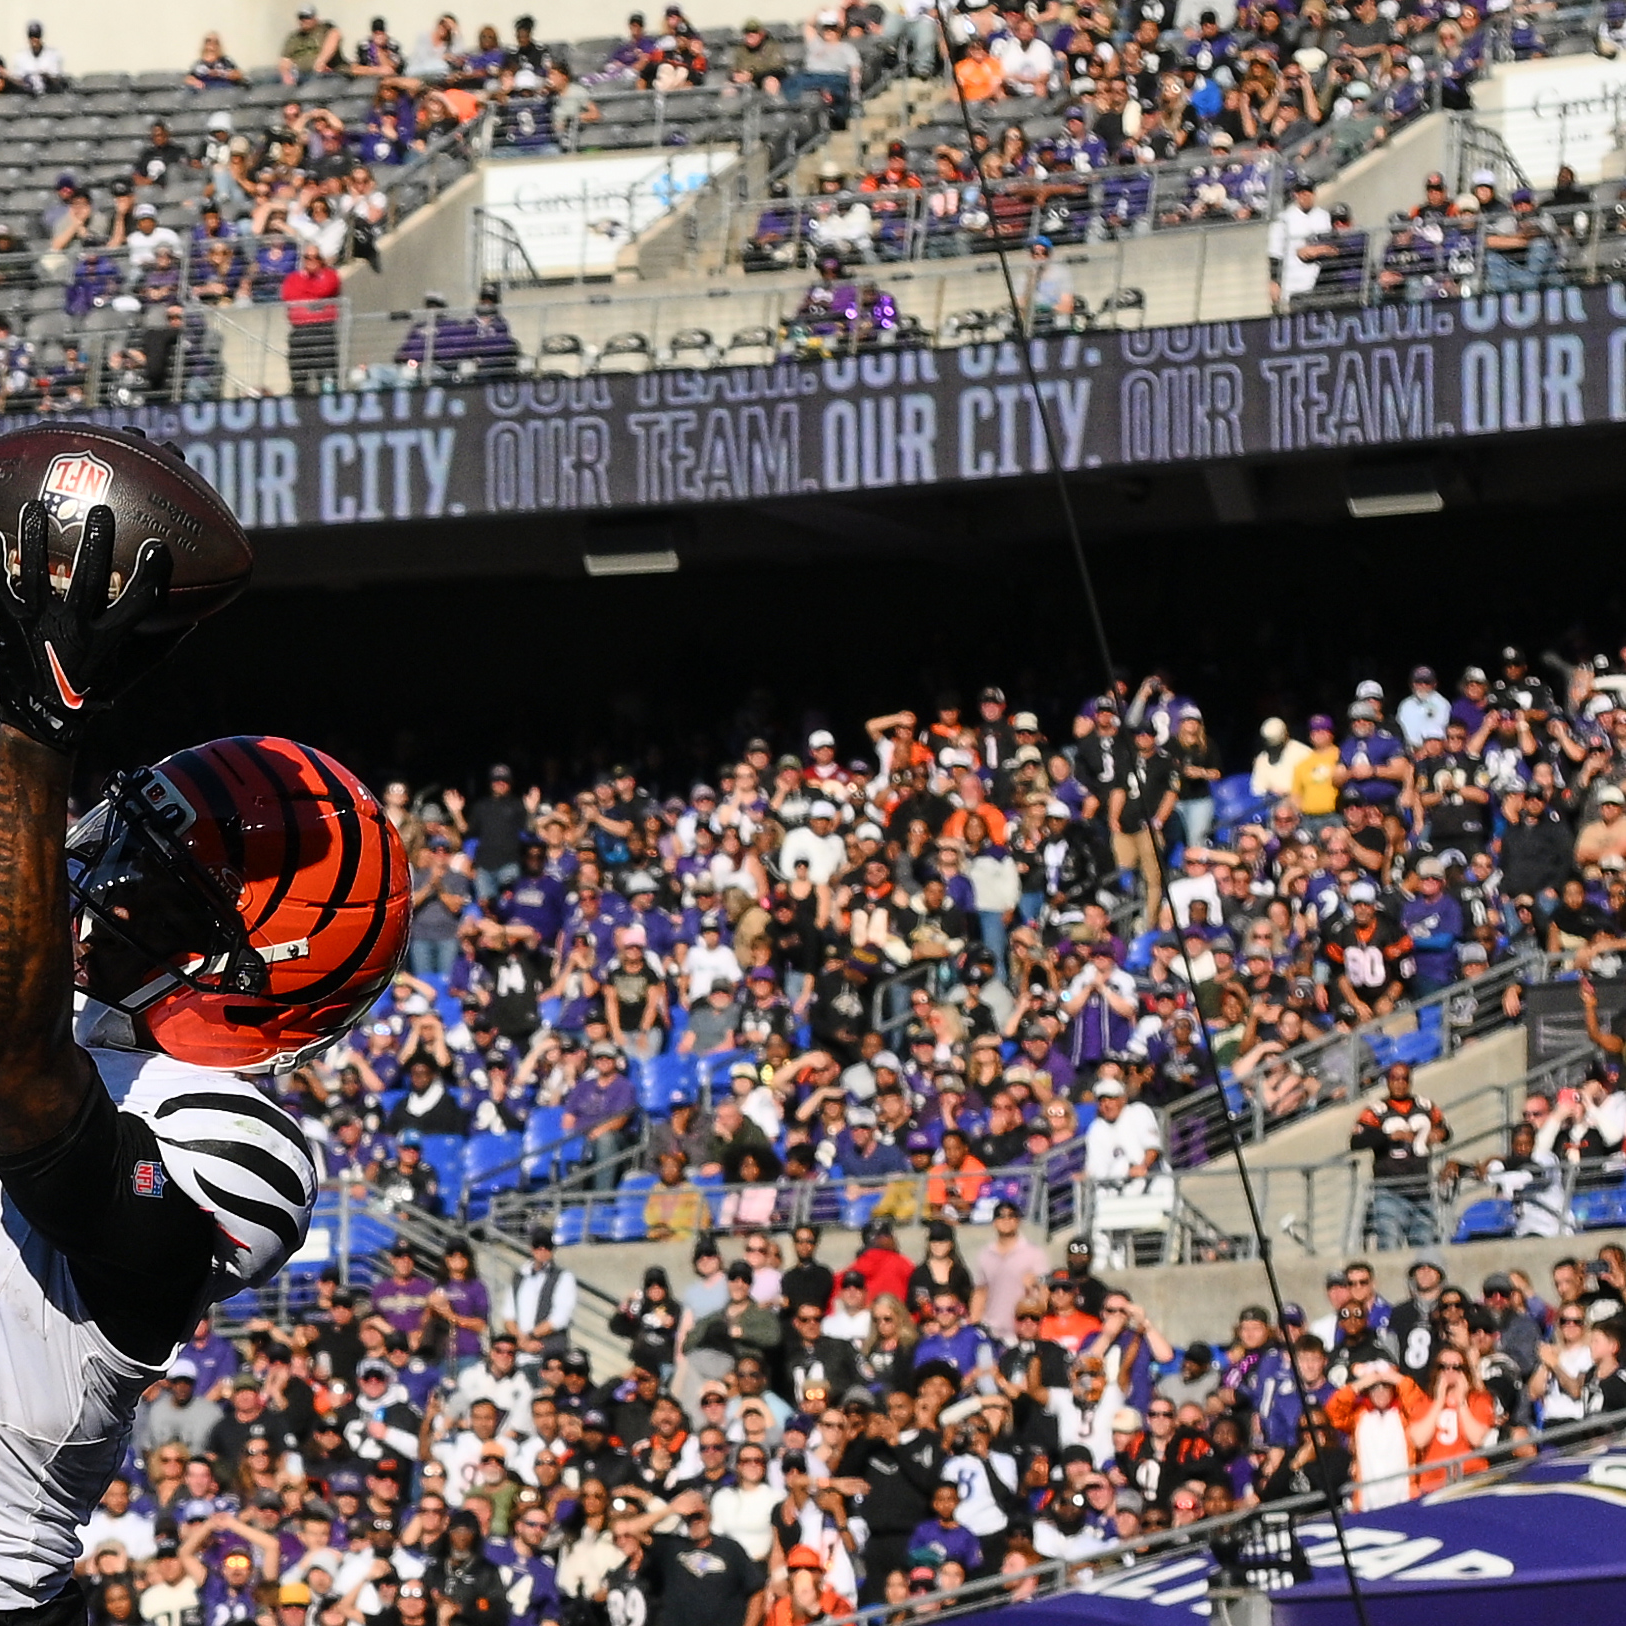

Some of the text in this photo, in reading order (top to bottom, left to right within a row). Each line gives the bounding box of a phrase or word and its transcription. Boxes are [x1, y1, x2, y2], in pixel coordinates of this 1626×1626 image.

[318, 430, 466, 528] CITY.
[483, 416, 611, 515] OUR
[629, 405, 821, 508] TEAM.
[822, 396, 938, 492] OUR
[958, 379, 1102, 478] CITY.
[1119, 364, 1246, 467] OUR
[1262, 343, 1454, 456] TEAM.
[1462, 330, 1585, 434] OUR
[55, 460, 106, 498] NFL
[136, 1165, 153, 1193] NFL
[1405, 1328, 1431, 1368] 8
[1437, 1408, 1459, 1445] 9
